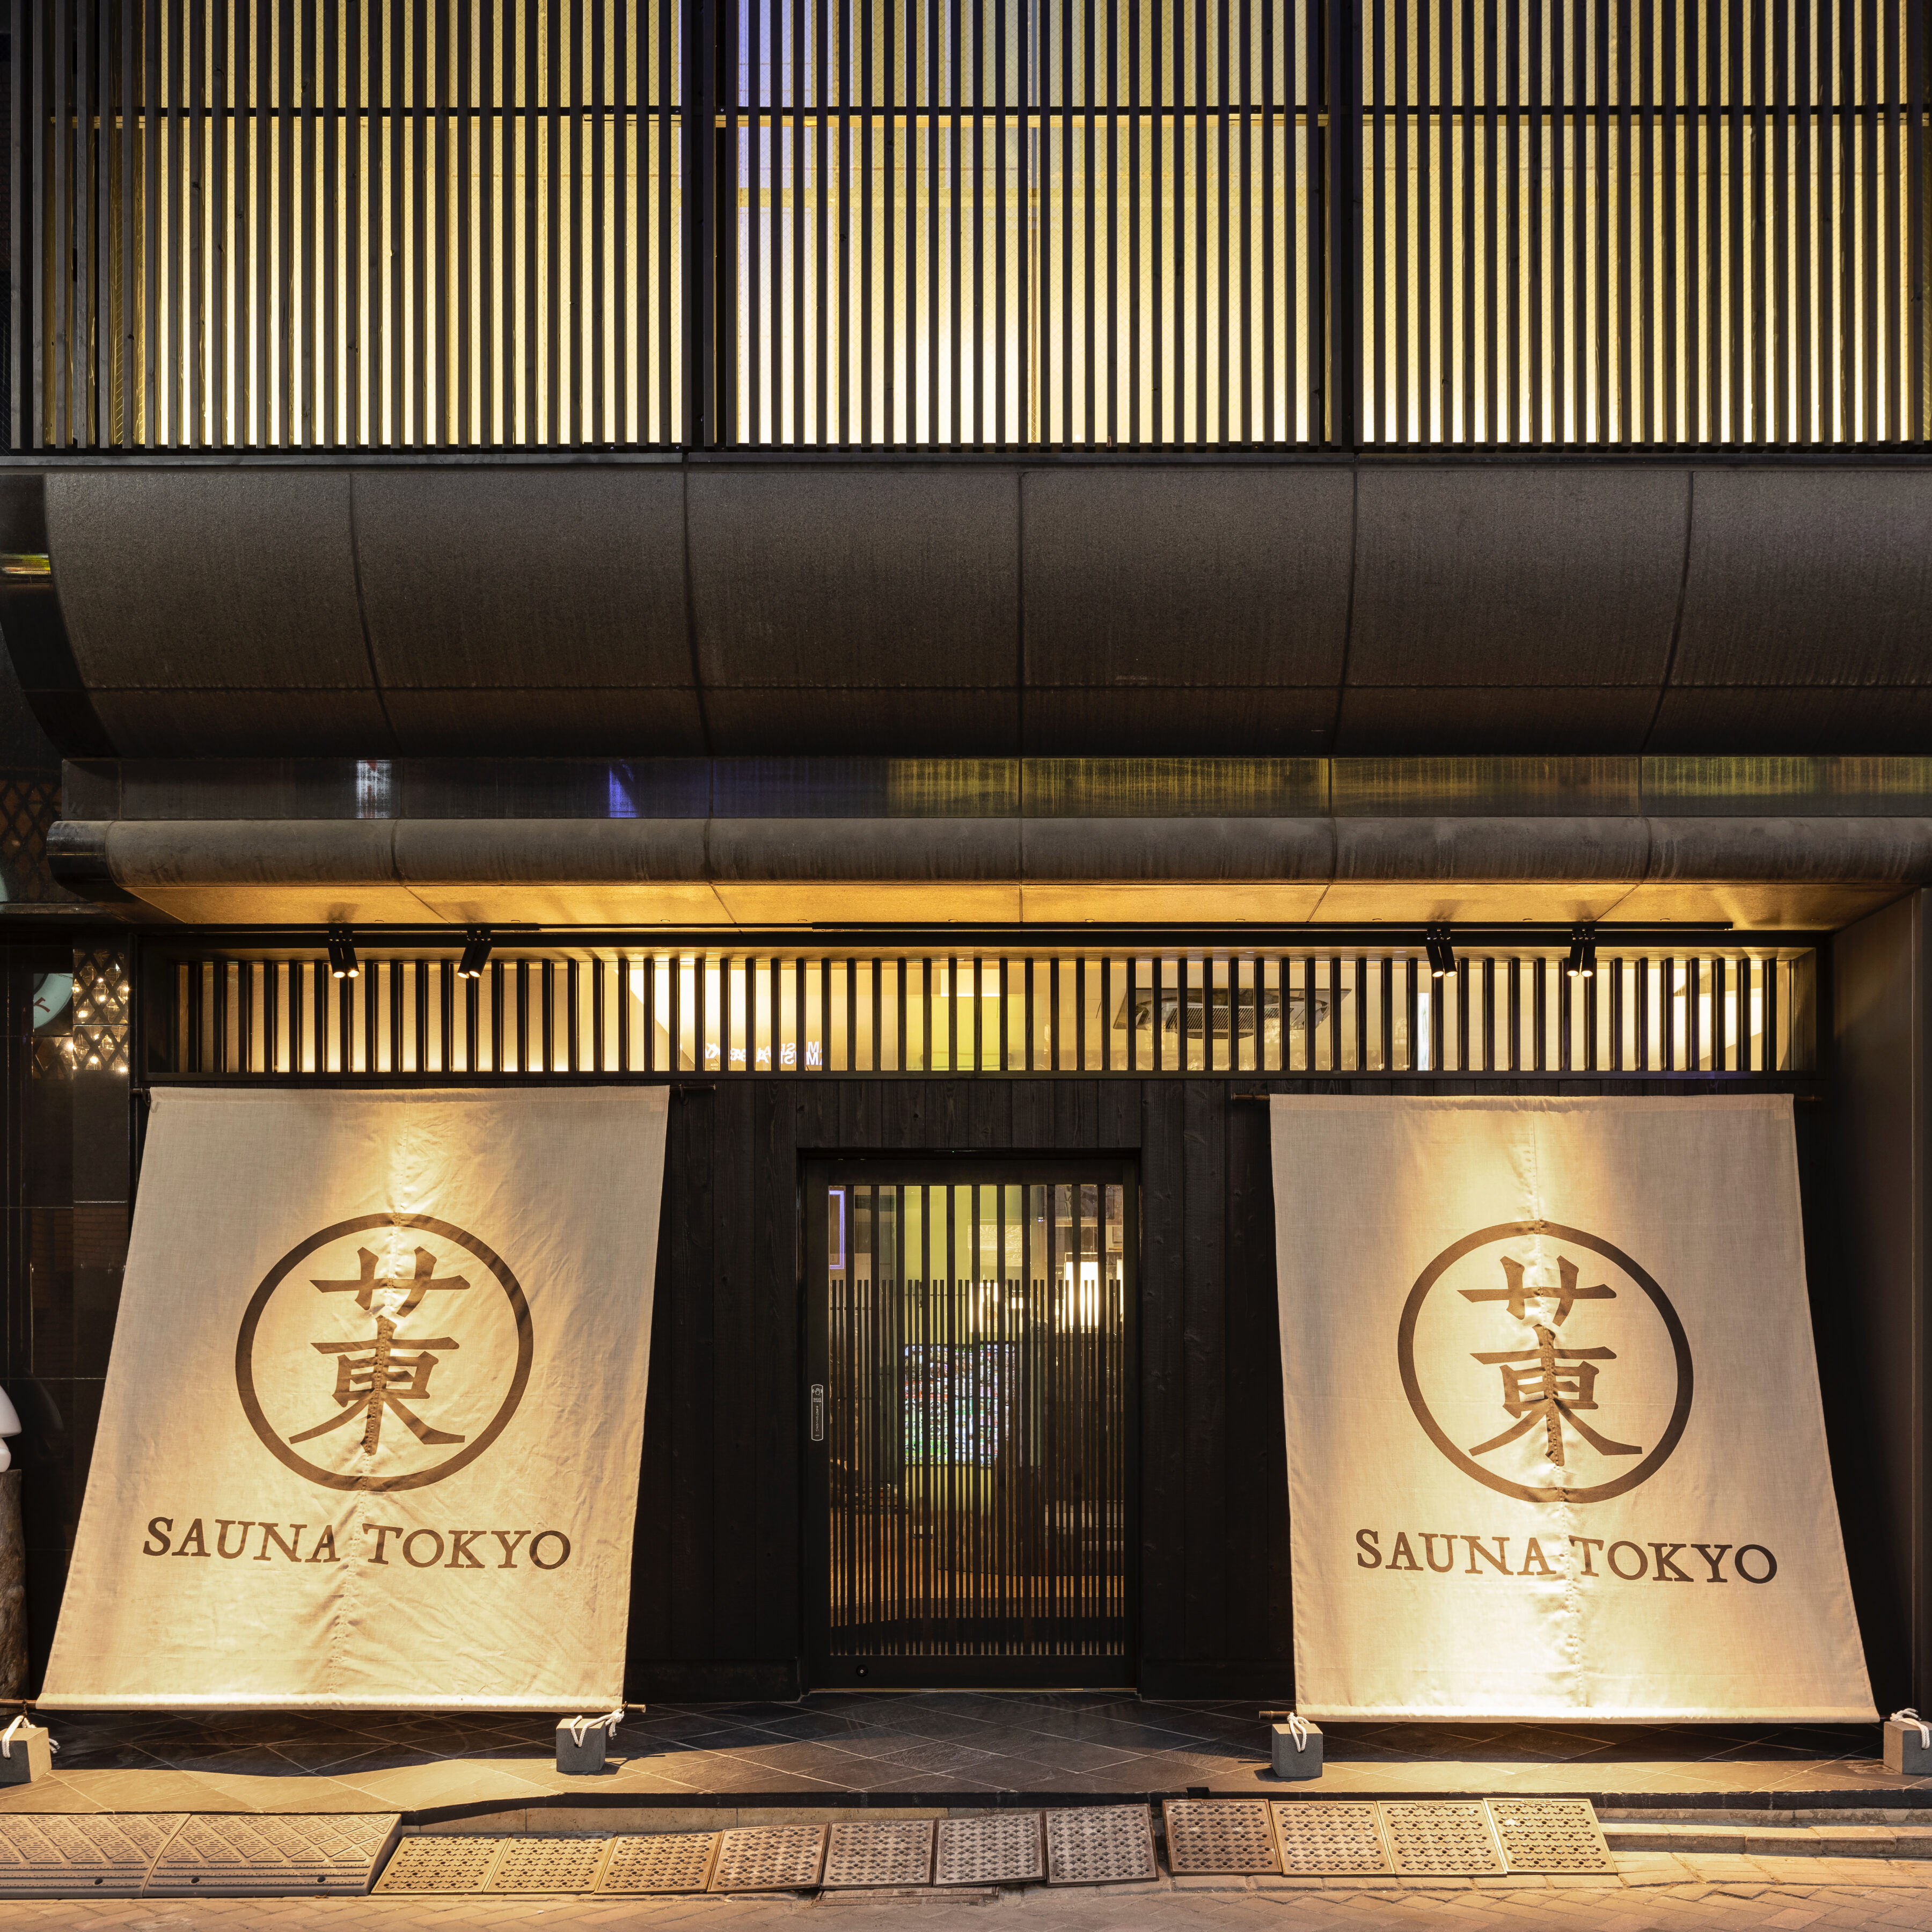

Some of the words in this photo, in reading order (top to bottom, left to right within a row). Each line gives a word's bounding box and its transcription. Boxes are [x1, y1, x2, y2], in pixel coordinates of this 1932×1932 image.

[143, 1517, 341, 1563] SAUNA
[362, 1523, 570, 1570] TOKYO
[1356, 1529, 1556, 1575] SAUNA
[1568, 1535, 1777, 1584] TOKYO
